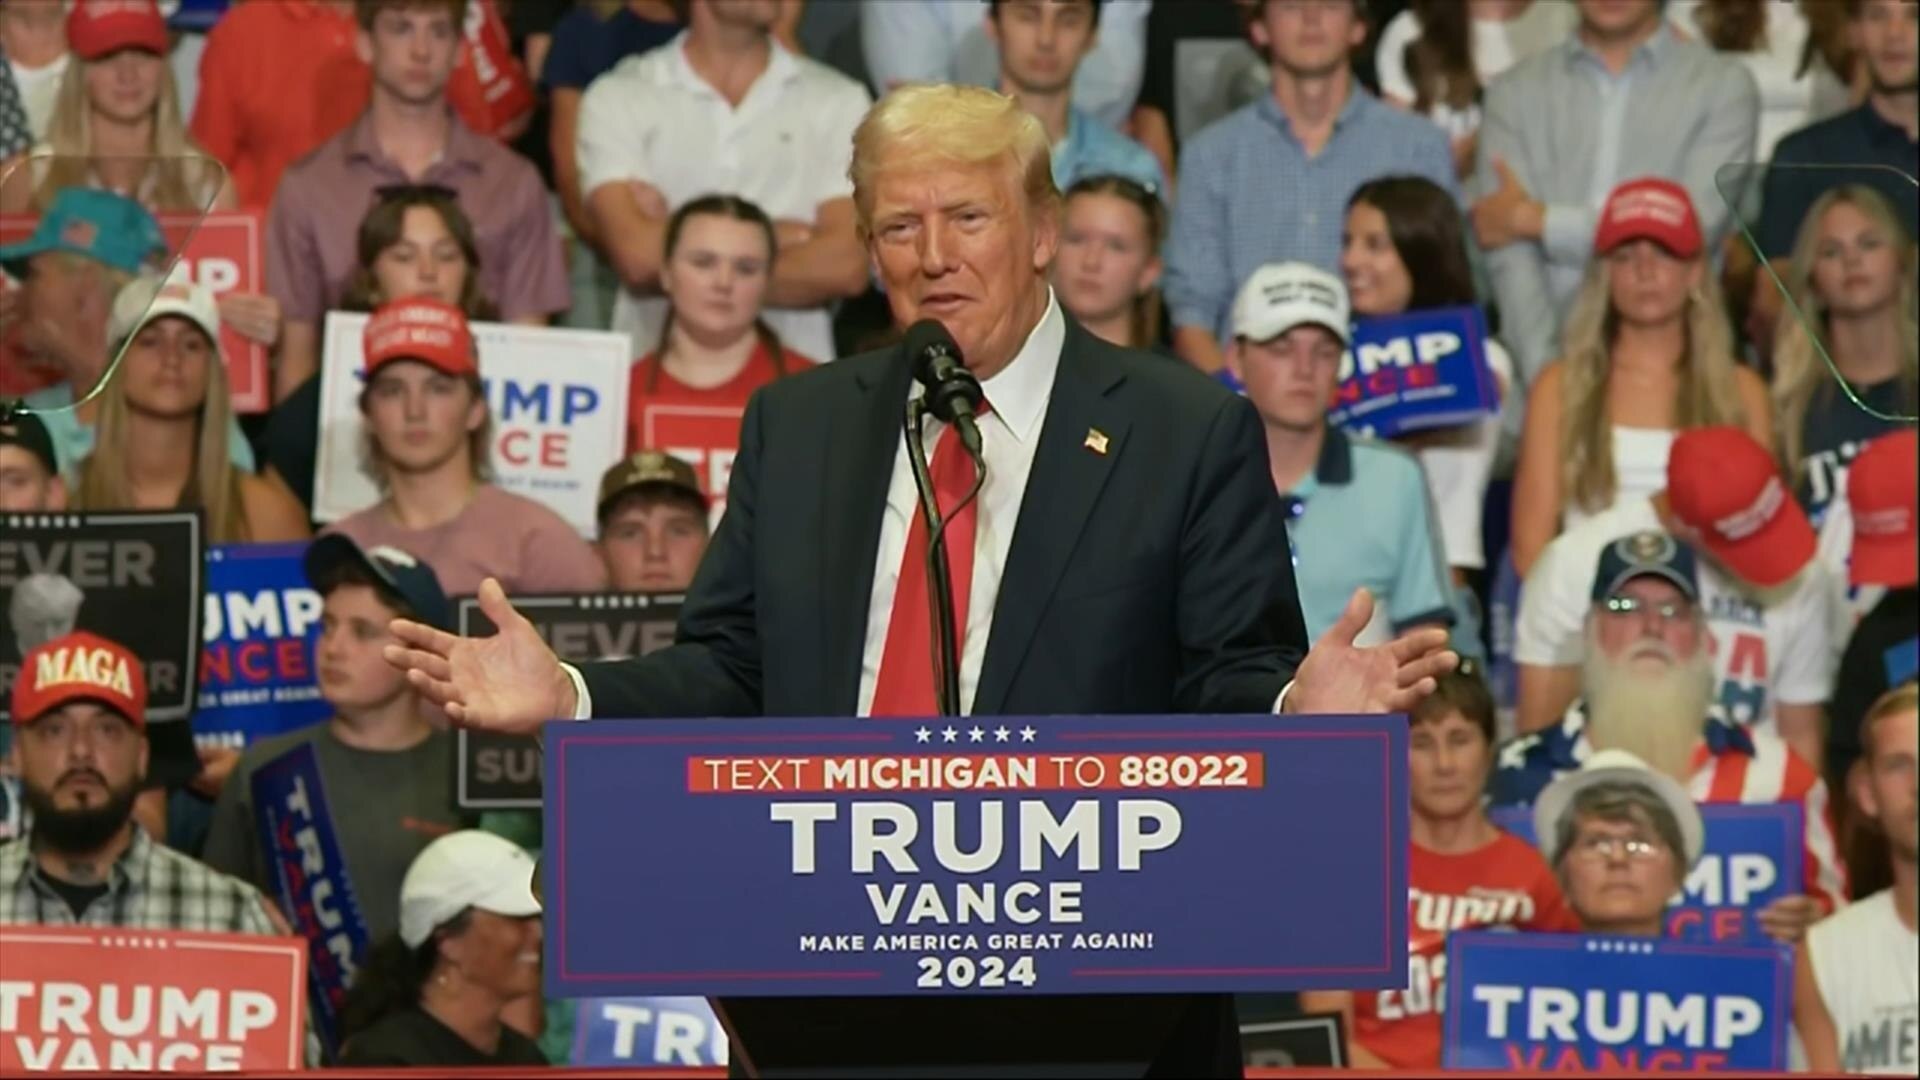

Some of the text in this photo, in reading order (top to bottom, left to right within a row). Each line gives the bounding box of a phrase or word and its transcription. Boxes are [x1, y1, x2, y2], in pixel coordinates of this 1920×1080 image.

[34, 646, 135, 699] MAGA
[704, 754, 1249, 790] TEXT MICHIGAN TO 88022
[770, 799, 1182, 874] TRUMP
[865, 881, 1083, 925] VANCE
[800, 932, 1154, 951] MAKE AMERICA GREAT AGAIN!
[916, 955, 1037, 988] 2024
[0, 980, 278, 1042] TRUMP
[1472, 984, 1763, 1050] TRUMP
[14, 1035, 244, 1071] VANCE
[1505, 1044, 1728, 1071] VANCE
